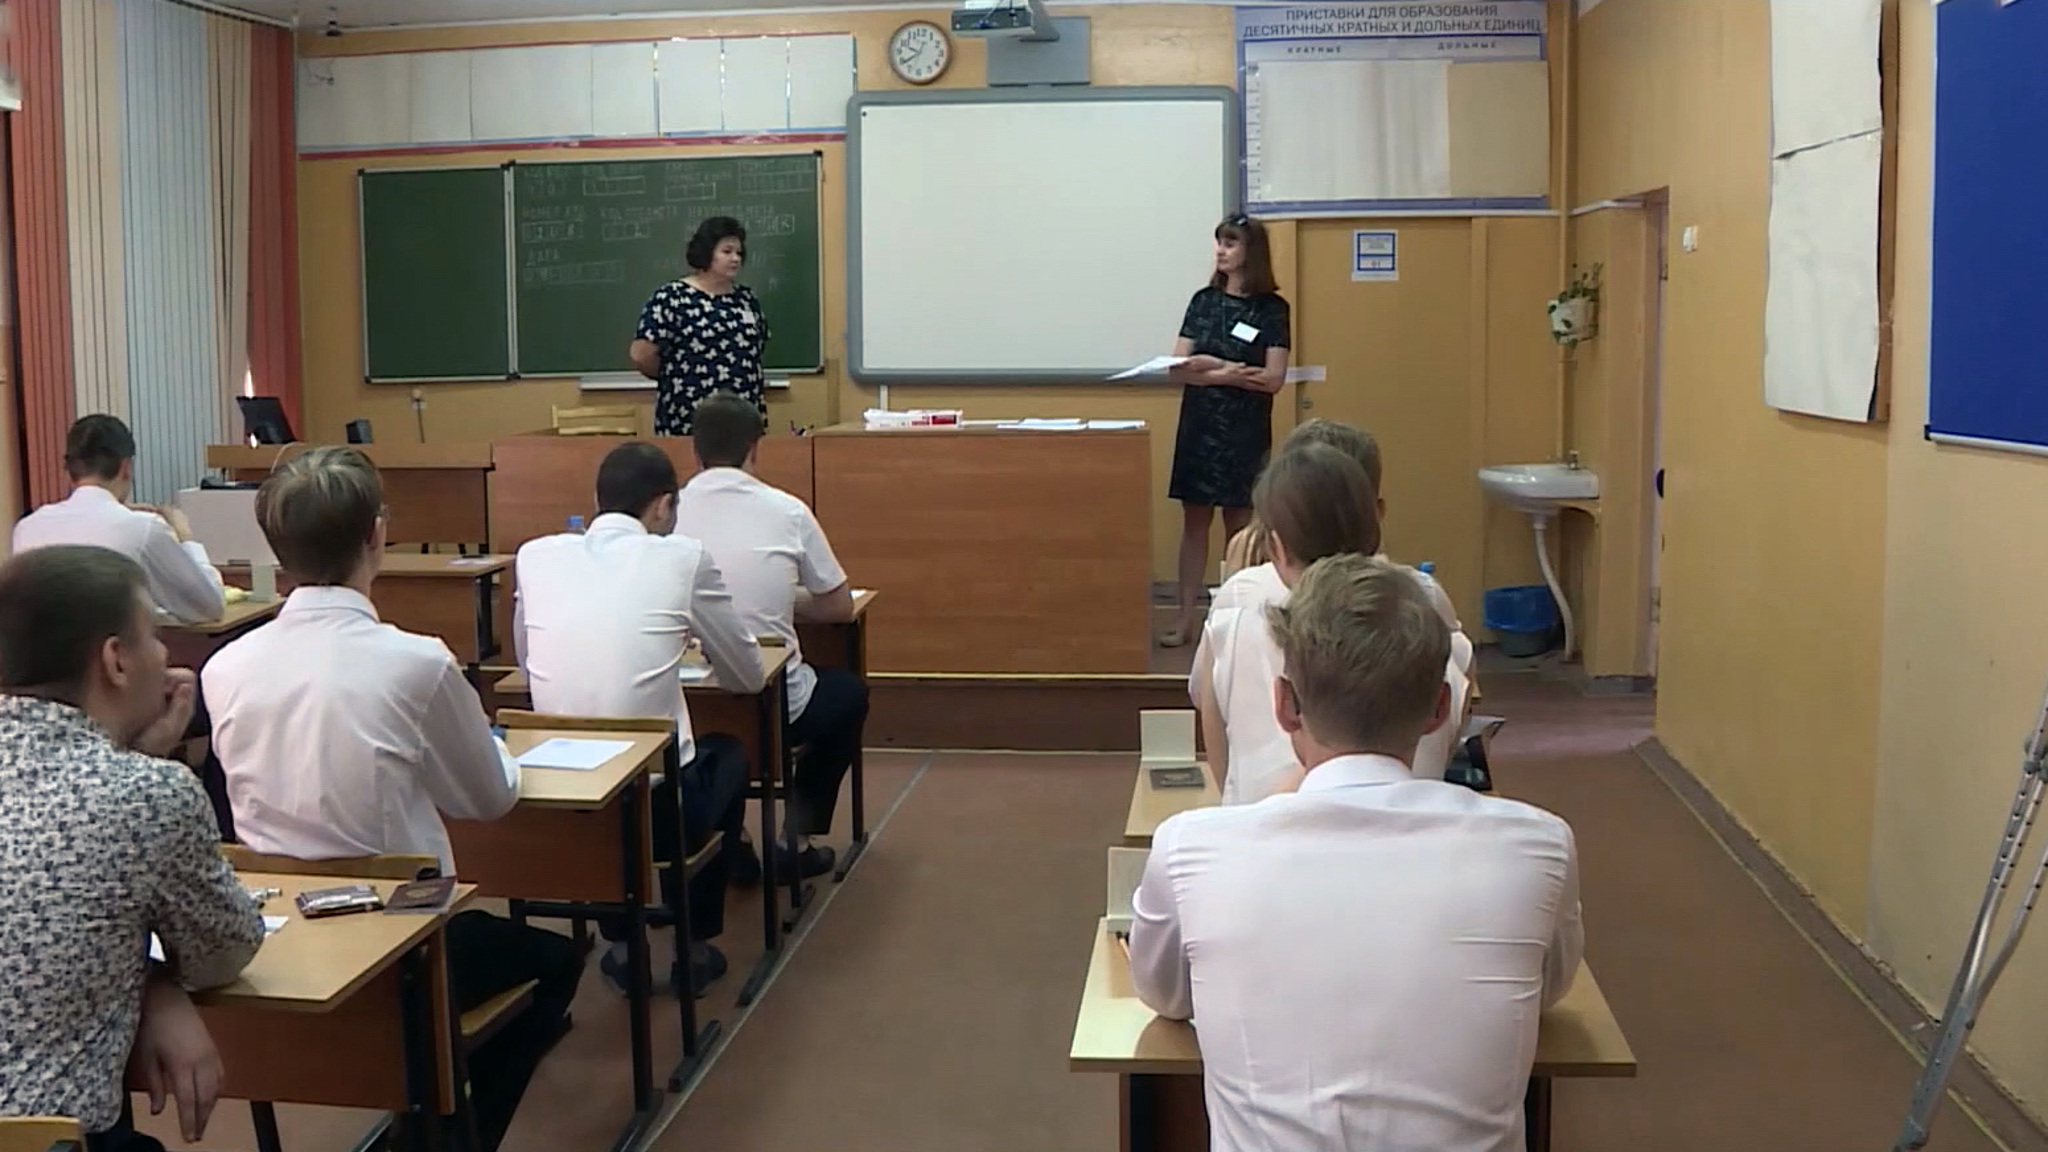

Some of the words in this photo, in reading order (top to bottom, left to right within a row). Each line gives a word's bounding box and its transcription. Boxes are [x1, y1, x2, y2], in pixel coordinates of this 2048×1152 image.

[1286, 8, 1364, 21] ПРИСТАВКИ
[1368, 7, 1396, 19] ДЛЯ
[1399, 5, 1498, 18] ОБРАЗОВАНИЯ
[1243, 22, 1334, 37] ДЕСЯТИЧНЫХ
[1337, 22, 1398, 33] КРАТНЫХ
[1402, 21, 1411, 32] И
[1414, 20, 1481, 33] ДОЛЬНЫХ
[1485, 19, 1540, 32] ЕДИНИЦ
